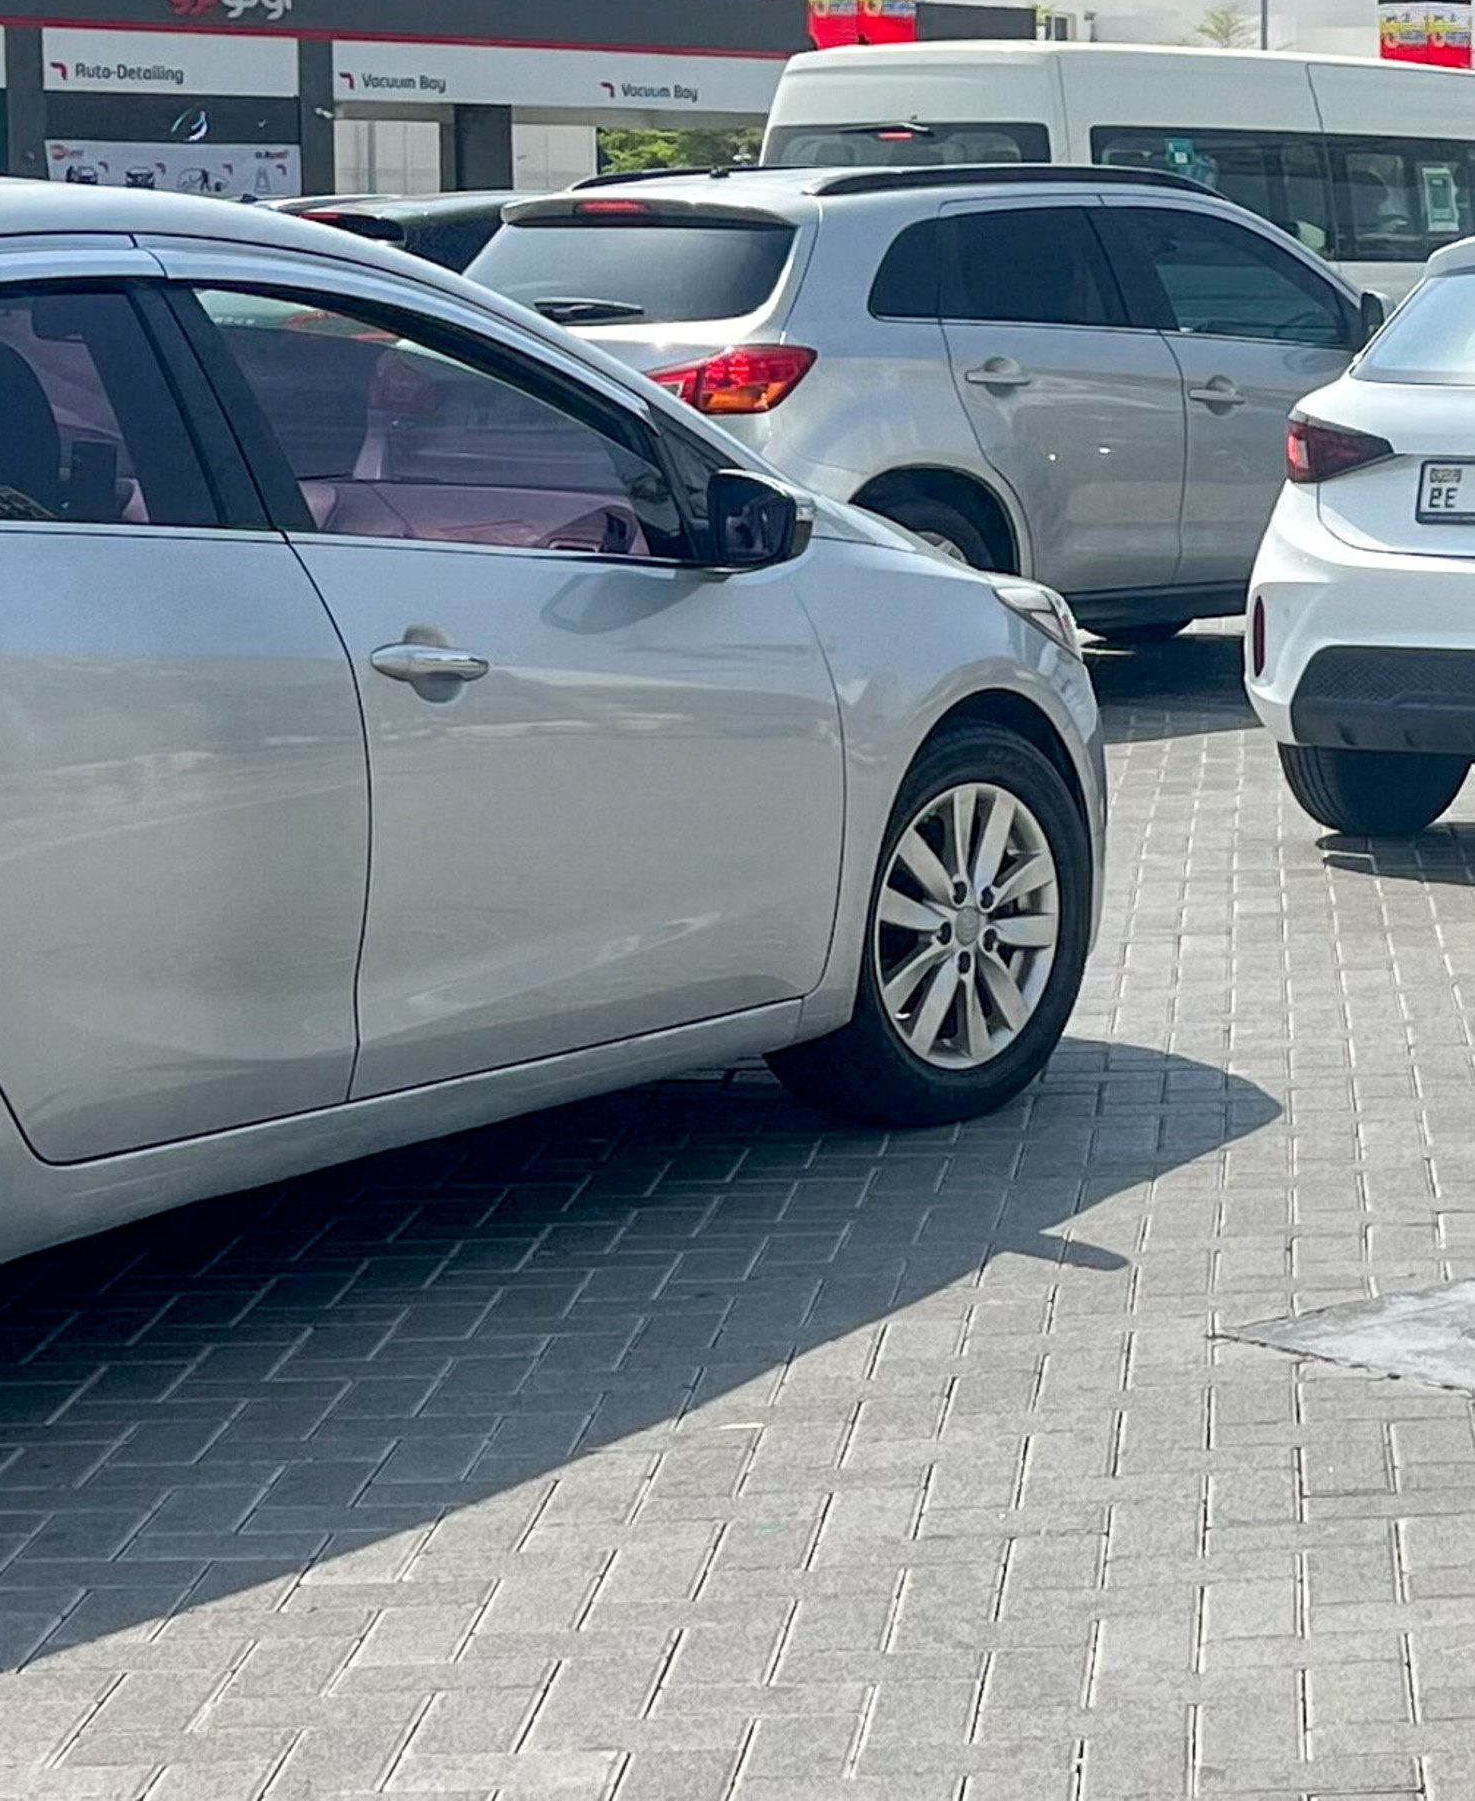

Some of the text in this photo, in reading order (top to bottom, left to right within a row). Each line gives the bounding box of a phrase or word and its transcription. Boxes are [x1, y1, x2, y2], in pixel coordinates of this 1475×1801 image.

[75, 63, 184, 85] Auto-Detailing
[362, 73, 447, 93] Vacuum Bay
[621, 83, 699, 102] Vacuum Bay
